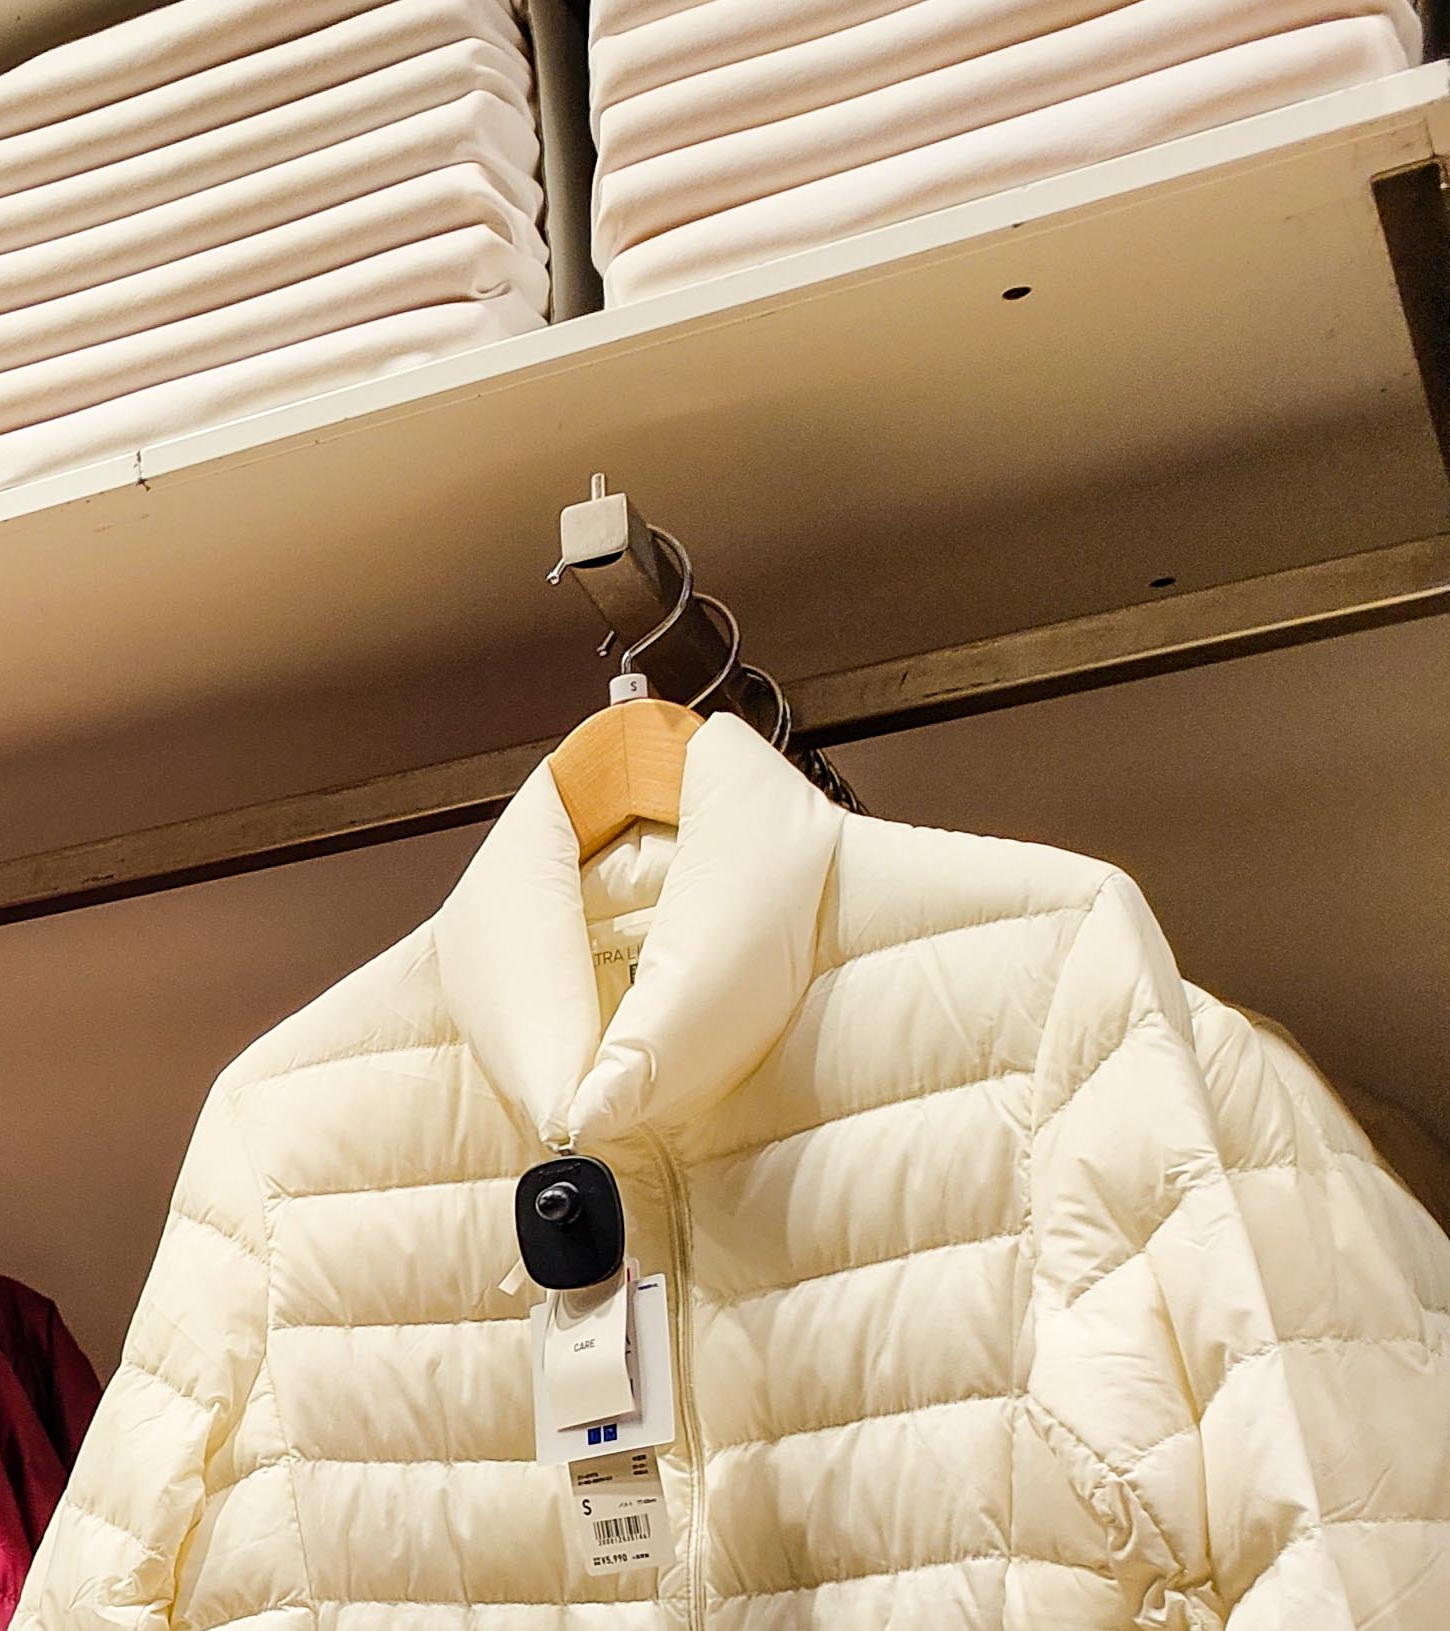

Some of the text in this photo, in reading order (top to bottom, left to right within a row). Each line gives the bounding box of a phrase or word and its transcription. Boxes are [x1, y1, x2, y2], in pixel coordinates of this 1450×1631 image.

[630, 681, 637, 691] S
[594, 949, 624, 966] TRA
[573, 1338, 596, 1353] CARE
[582, 1499, 592, 1516] S
